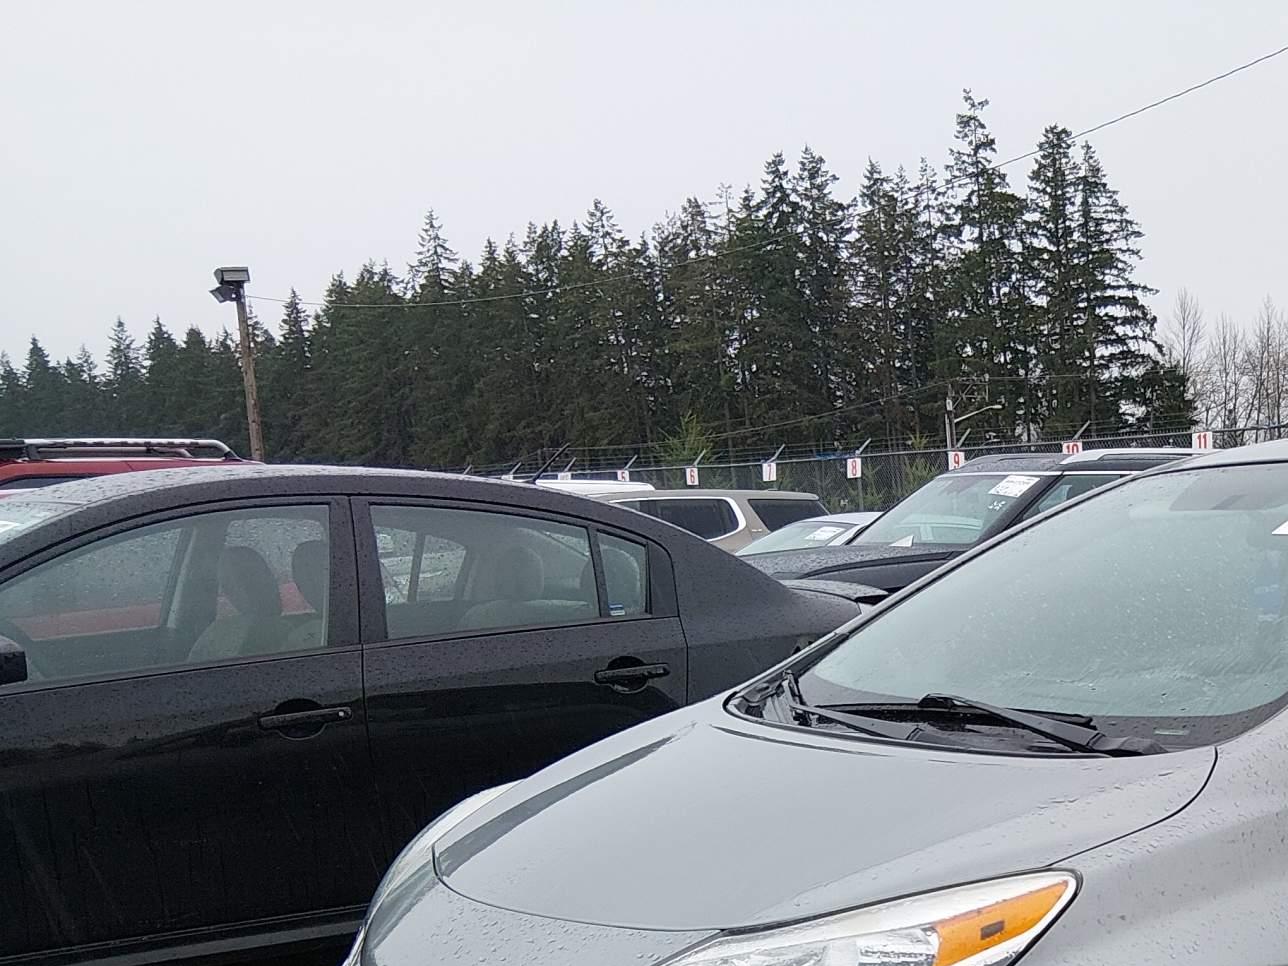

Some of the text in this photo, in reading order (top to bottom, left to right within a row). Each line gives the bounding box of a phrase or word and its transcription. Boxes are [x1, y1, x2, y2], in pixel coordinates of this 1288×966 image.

[851, 460, 858, 477] 8
[953, 453, 960, 469] 9
[689, 470, 696, 484] 6
[767, 464, 773, 480] 7
